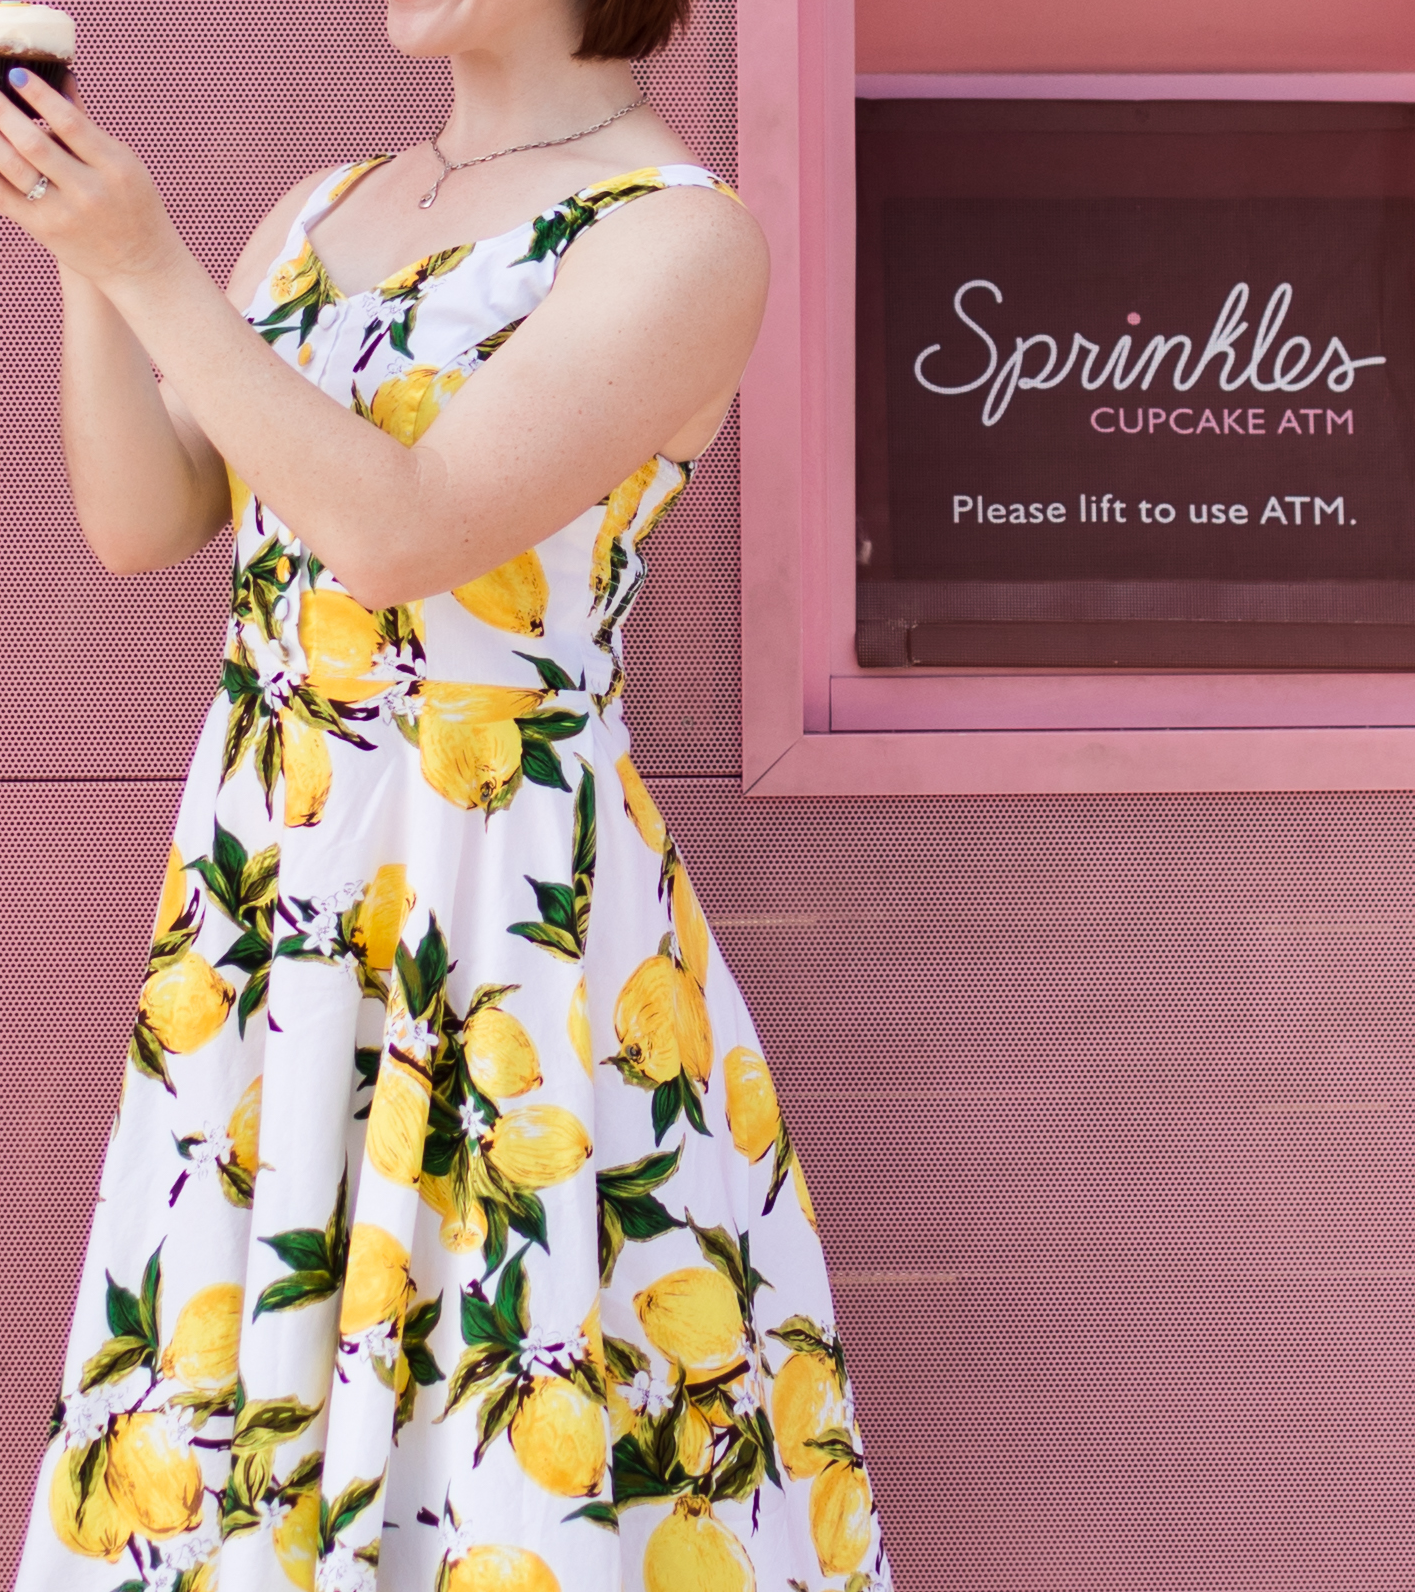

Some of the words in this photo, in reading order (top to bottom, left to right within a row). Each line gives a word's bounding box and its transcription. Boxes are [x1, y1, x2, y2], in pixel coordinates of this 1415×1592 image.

[914, 279, 1387, 427] Sprinkles
[1090, 407, 1266, 434] CUPCAKE
[1277, 409, 1355, 435] ATM
[953, 495, 1066, 523] Please
[1080, 495, 1127, 523] lift
[1138, 499, 1176, 524] to
[1189, 505, 1249, 524] use
[1260, 496, 1357, 526] ATM.
